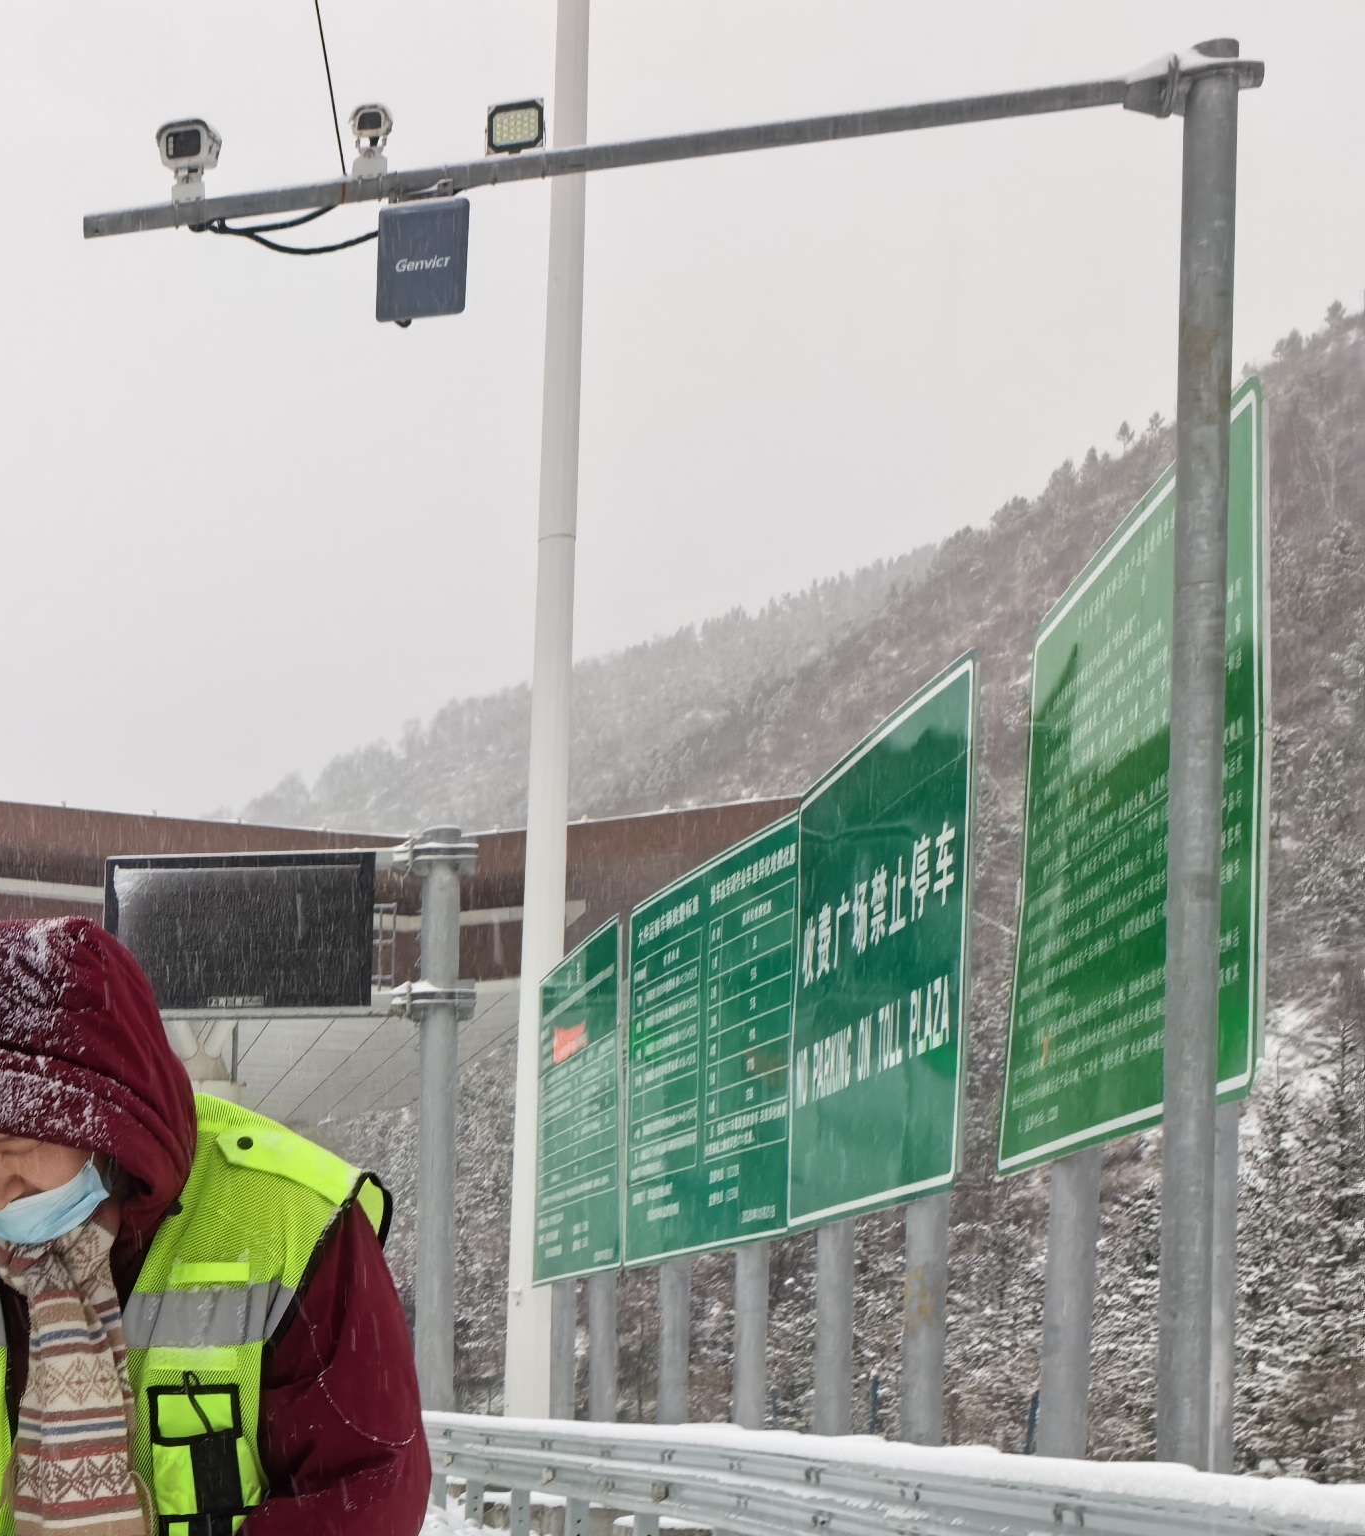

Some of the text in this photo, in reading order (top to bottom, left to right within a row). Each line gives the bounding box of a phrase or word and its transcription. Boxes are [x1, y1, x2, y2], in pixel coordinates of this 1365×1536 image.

[802, 821, 955, 988] 收费广场禁止停车
[812, 1024, 851, 1101] PARKING
[857, 1014, 872, 1082] ON
[878, 998, 902, 1073] TOLL
[909, 974, 950, 1059] PLAZA
